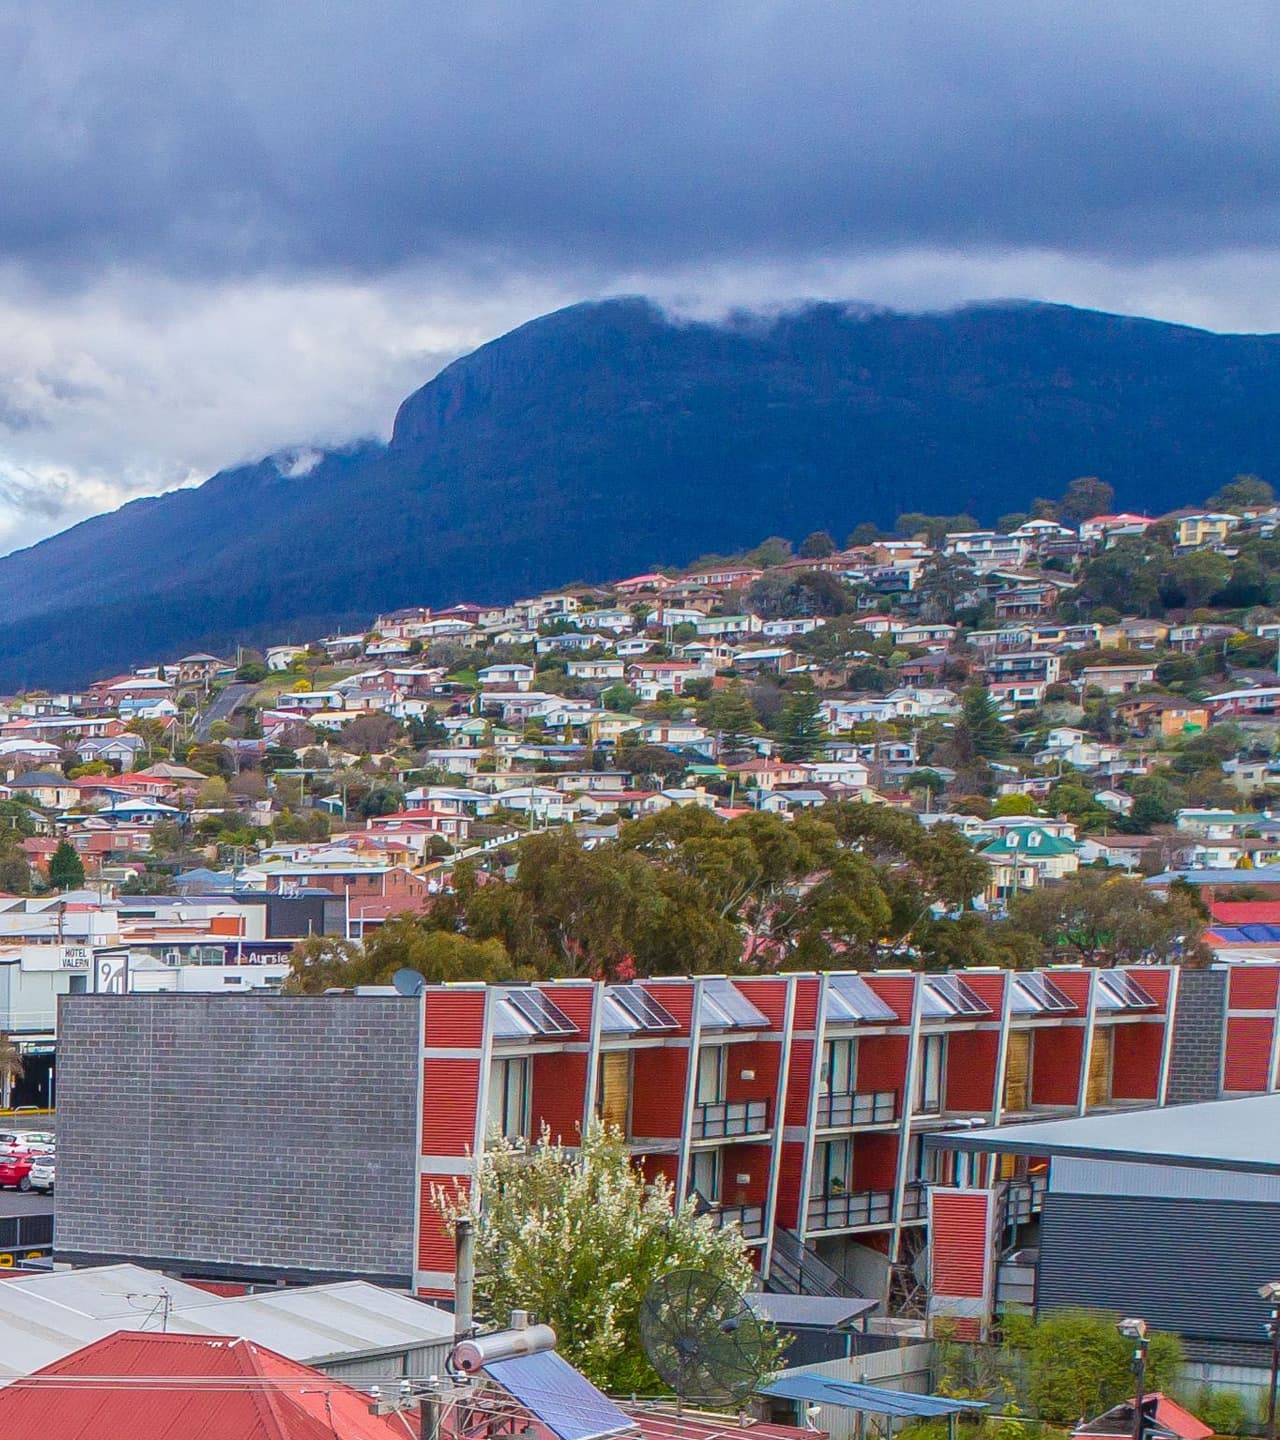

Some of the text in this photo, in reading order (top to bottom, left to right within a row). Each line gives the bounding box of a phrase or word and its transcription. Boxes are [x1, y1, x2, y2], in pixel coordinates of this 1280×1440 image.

[65, 948, 87, 957] HOTEL
[249, 952, 289, 963] Ausie
[62, 959, 89, 967] VALERN
